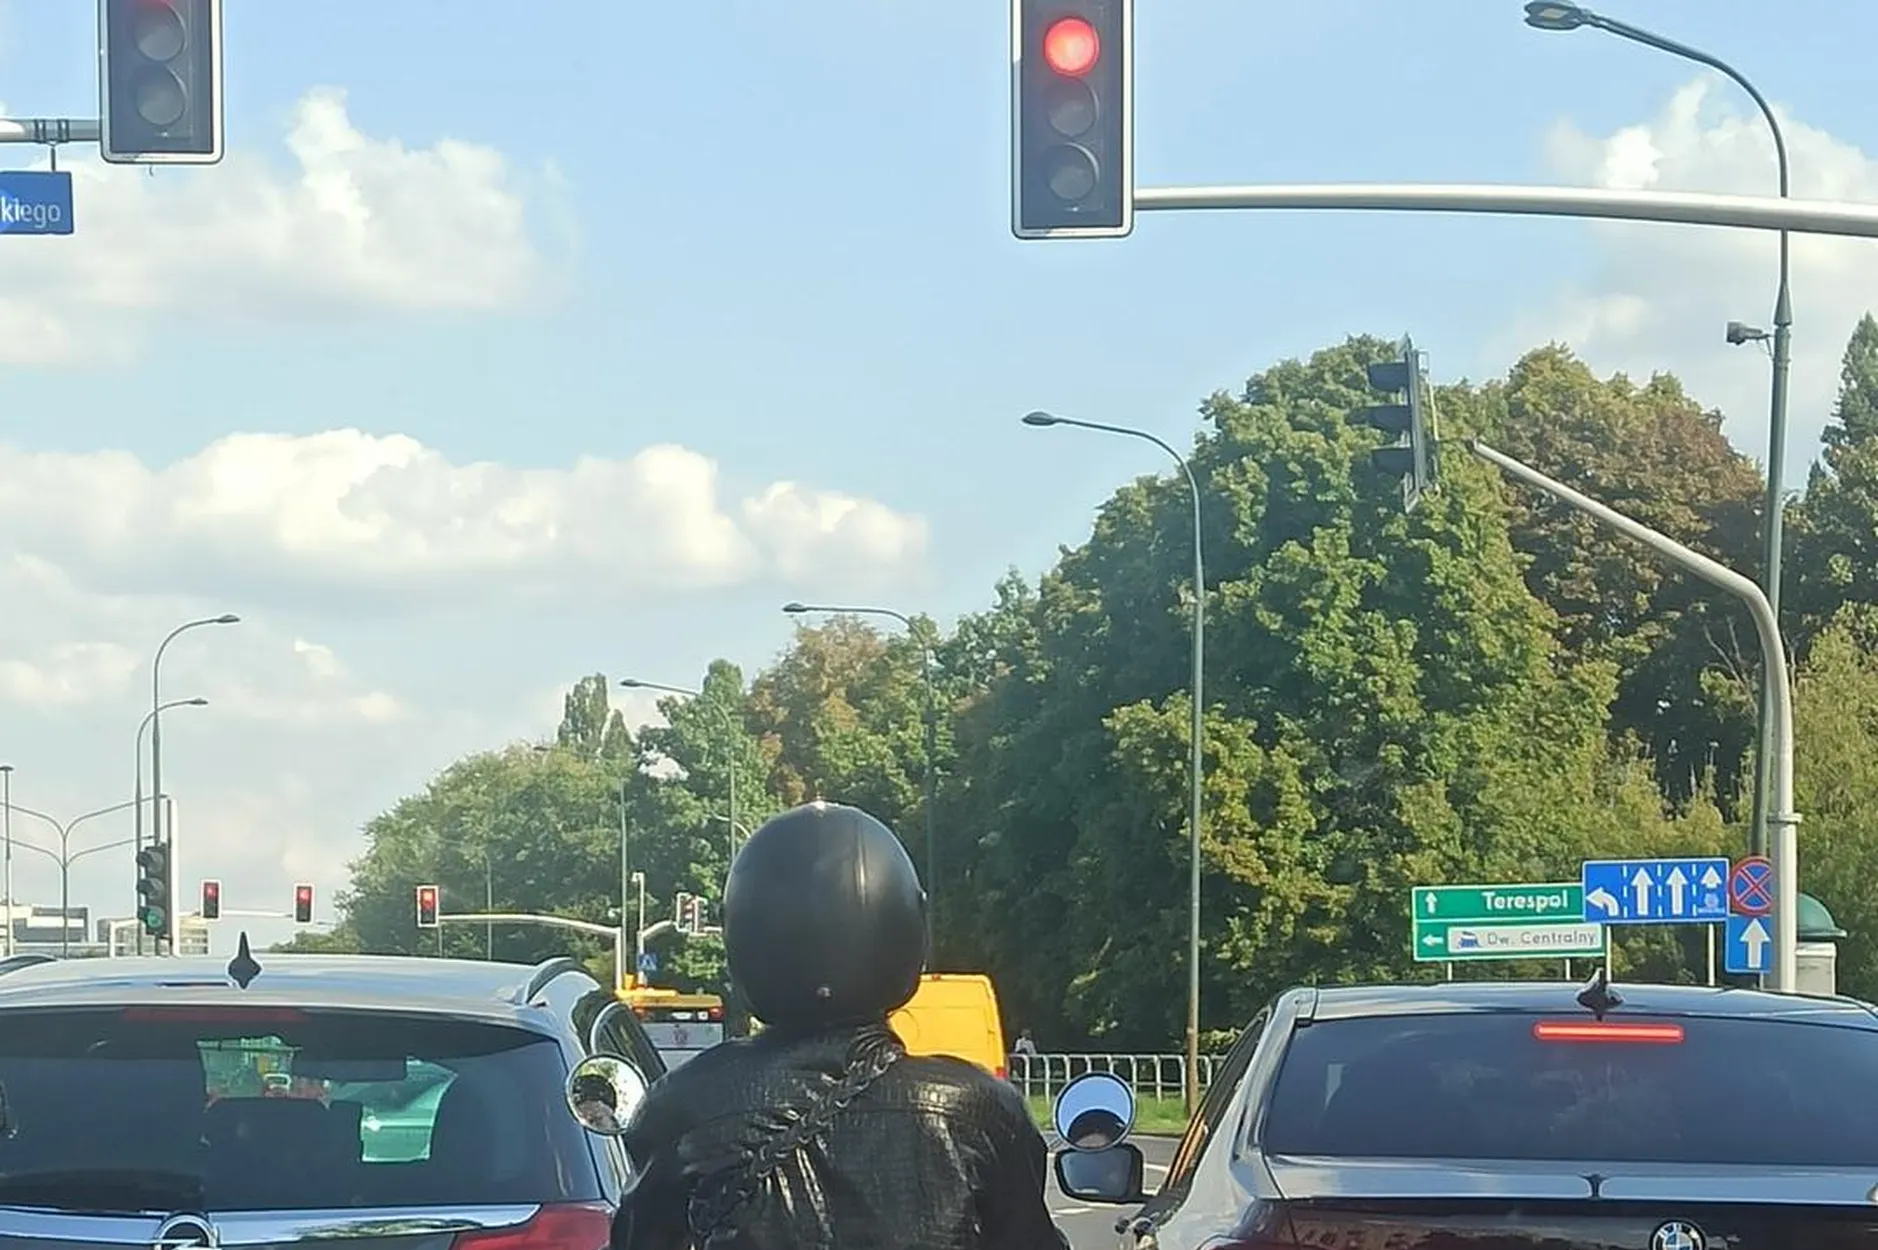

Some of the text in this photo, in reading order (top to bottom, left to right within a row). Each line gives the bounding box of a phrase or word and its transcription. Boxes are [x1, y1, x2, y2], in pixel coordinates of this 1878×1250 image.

[1, 195, 62, 229] kiego
[1481, 889, 1568, 913] Terespol
[1486, 928, 1597, 948] Dw. Centralny
